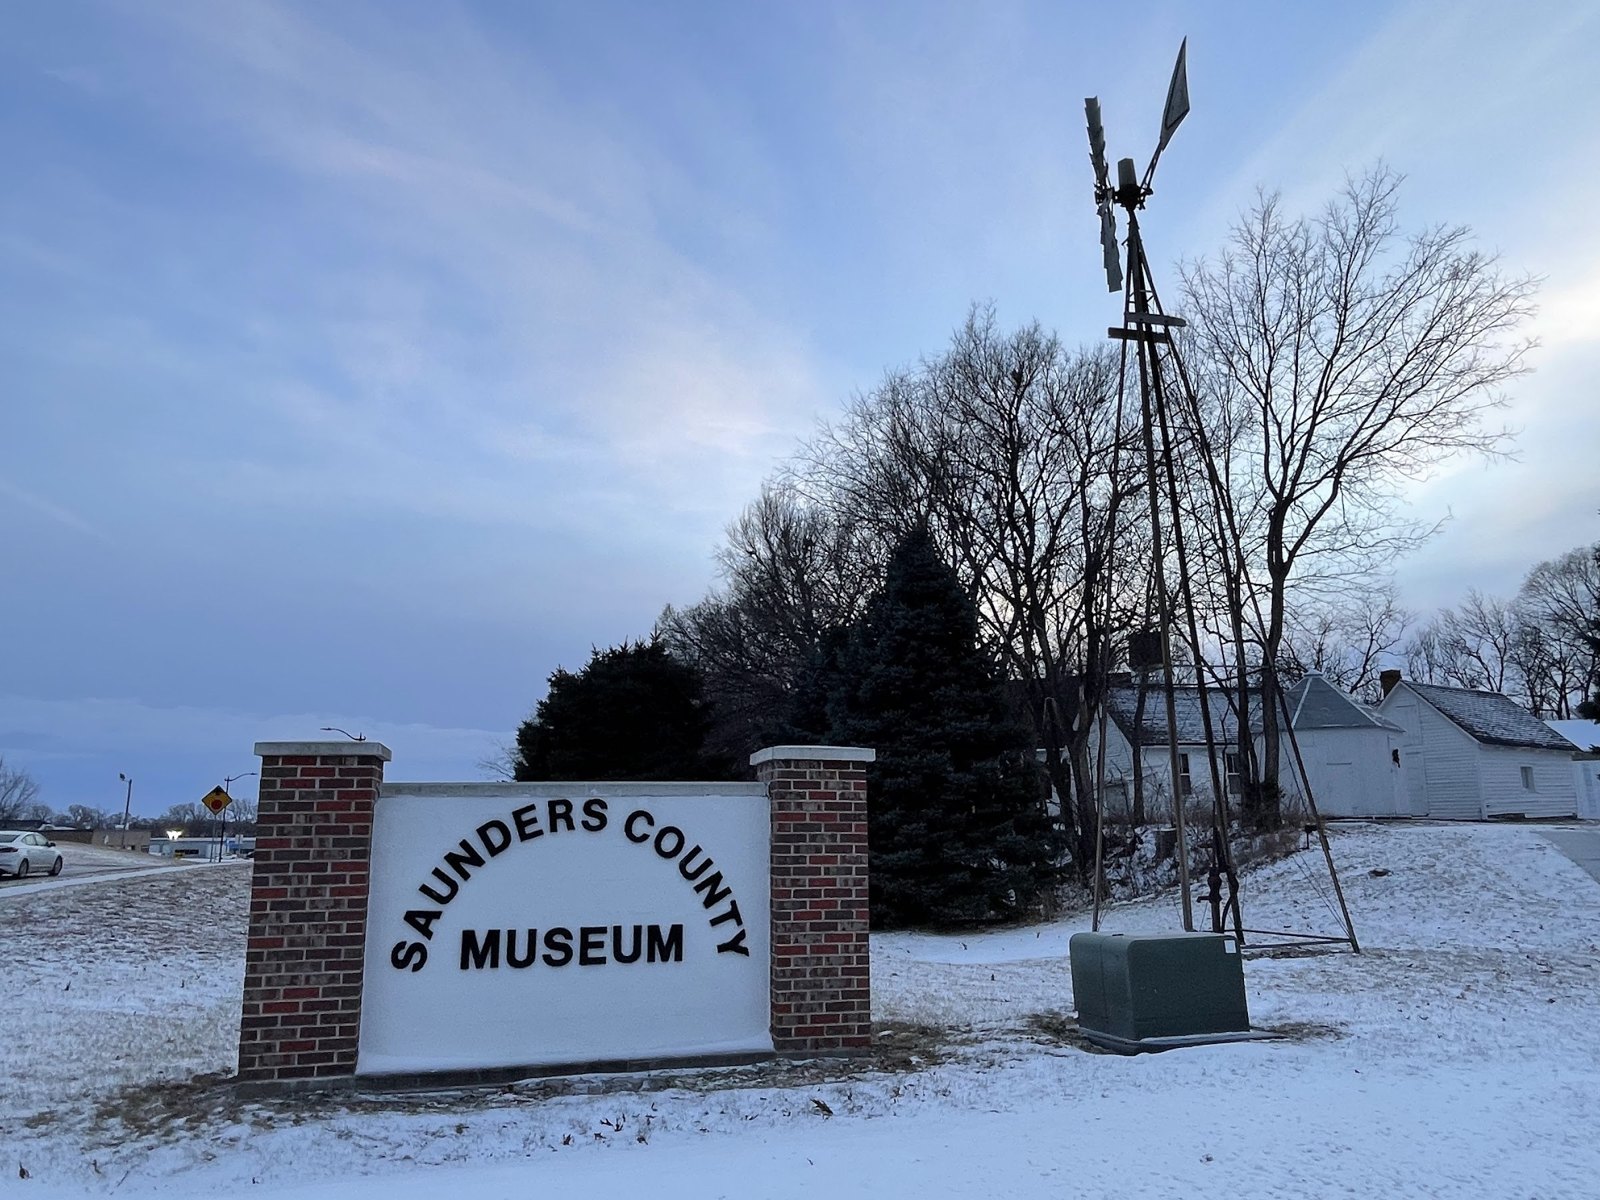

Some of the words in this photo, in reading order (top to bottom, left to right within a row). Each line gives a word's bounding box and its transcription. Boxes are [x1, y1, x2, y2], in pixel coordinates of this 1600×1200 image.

[390, 798, 609, 973] SAUNDERS
[623, 809, 750, 958] COUNTY
[459, 923, 684, 971] MUSEUM
